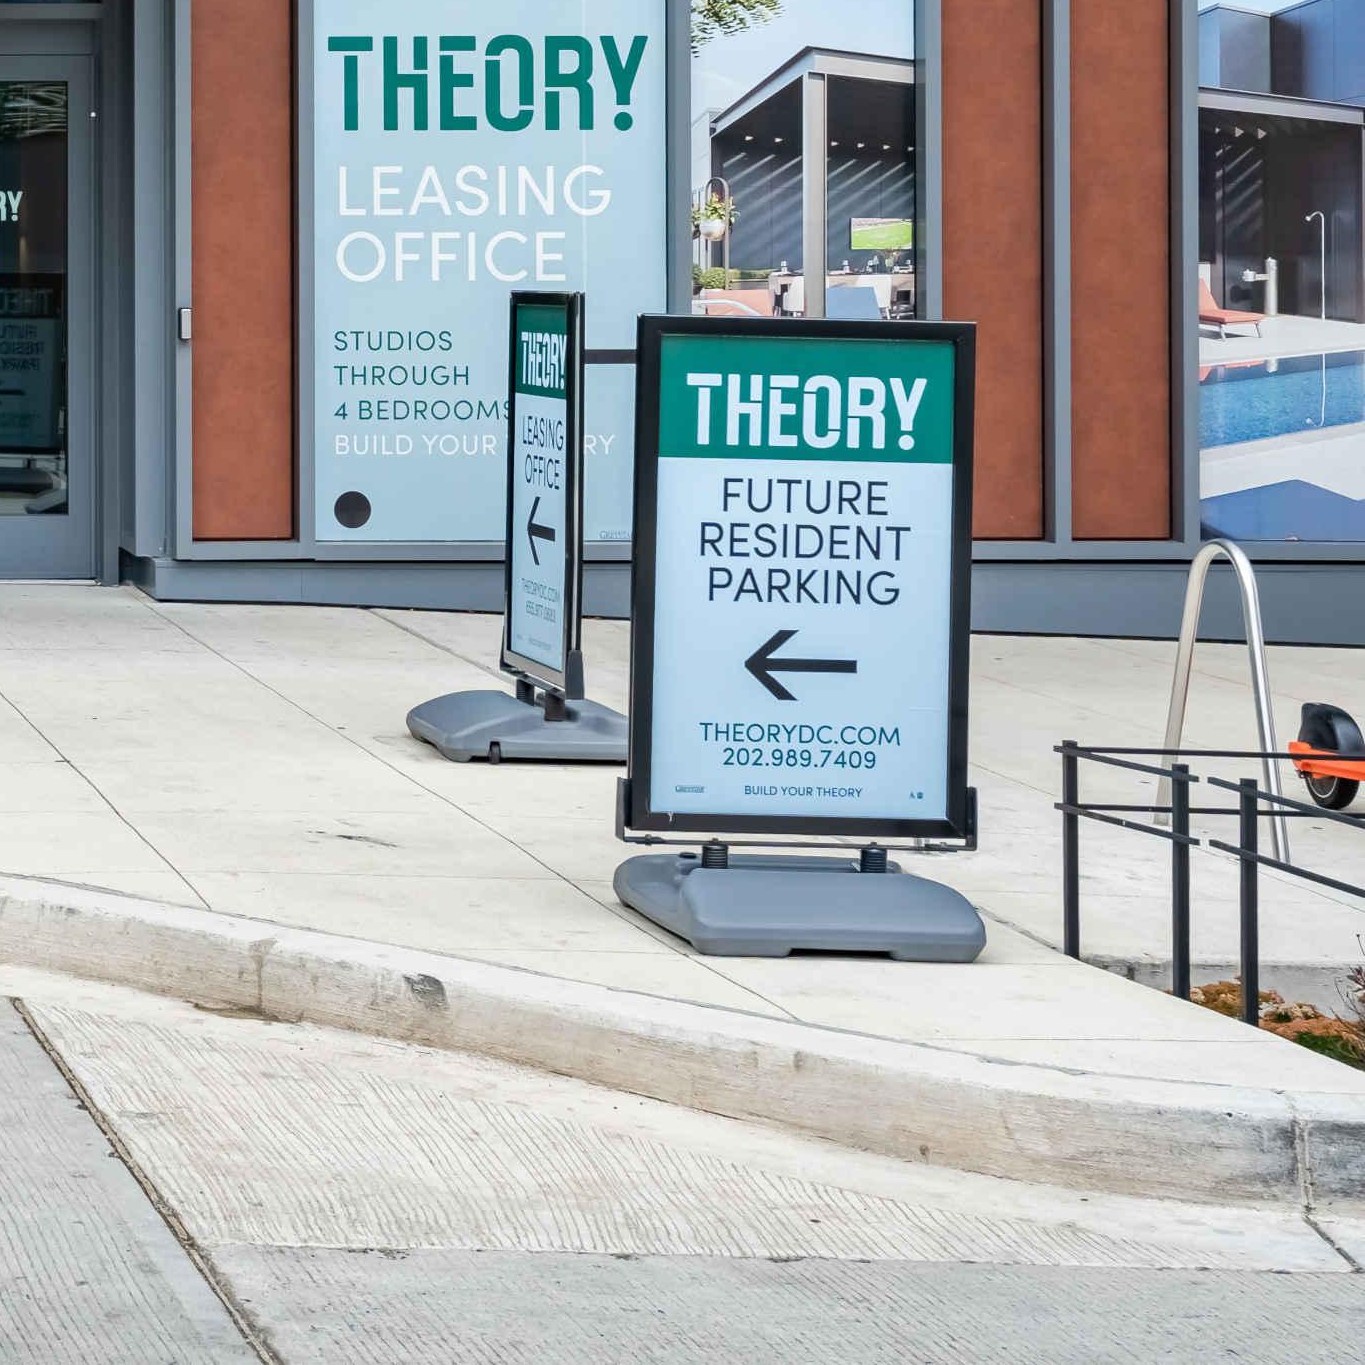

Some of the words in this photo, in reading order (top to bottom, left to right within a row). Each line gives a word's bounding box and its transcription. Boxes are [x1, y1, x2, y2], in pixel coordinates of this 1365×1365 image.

[337, 163, 613, 217] LEASING
[335, 231, 567, 283] OFFICE
[333, 330, 453, 351] STUDIOS
[333, 365, 469, 386] THROUGH
[333, 401, 349, 420] 4
[334, 434, 413, 455] BUILD
[421, 434, 497, 455] YOUR
[522, 414, 564, 451] LEASING
[524, 453, 561, 491] OFFICE
[722, 478, 889, 517] FUTURE
[699, 522, 912, 563] RESIDENT
[707, 566, 902, 607] PARKING
[699, 722, 901, 746] THEORYDC.COM
[722, 747, 877, 769] 202.989.7409
[744, 785, 778, 796] BUILD
[780, 786, 813, 797] YOUR
[816, 787, 863, 798] THEORY
